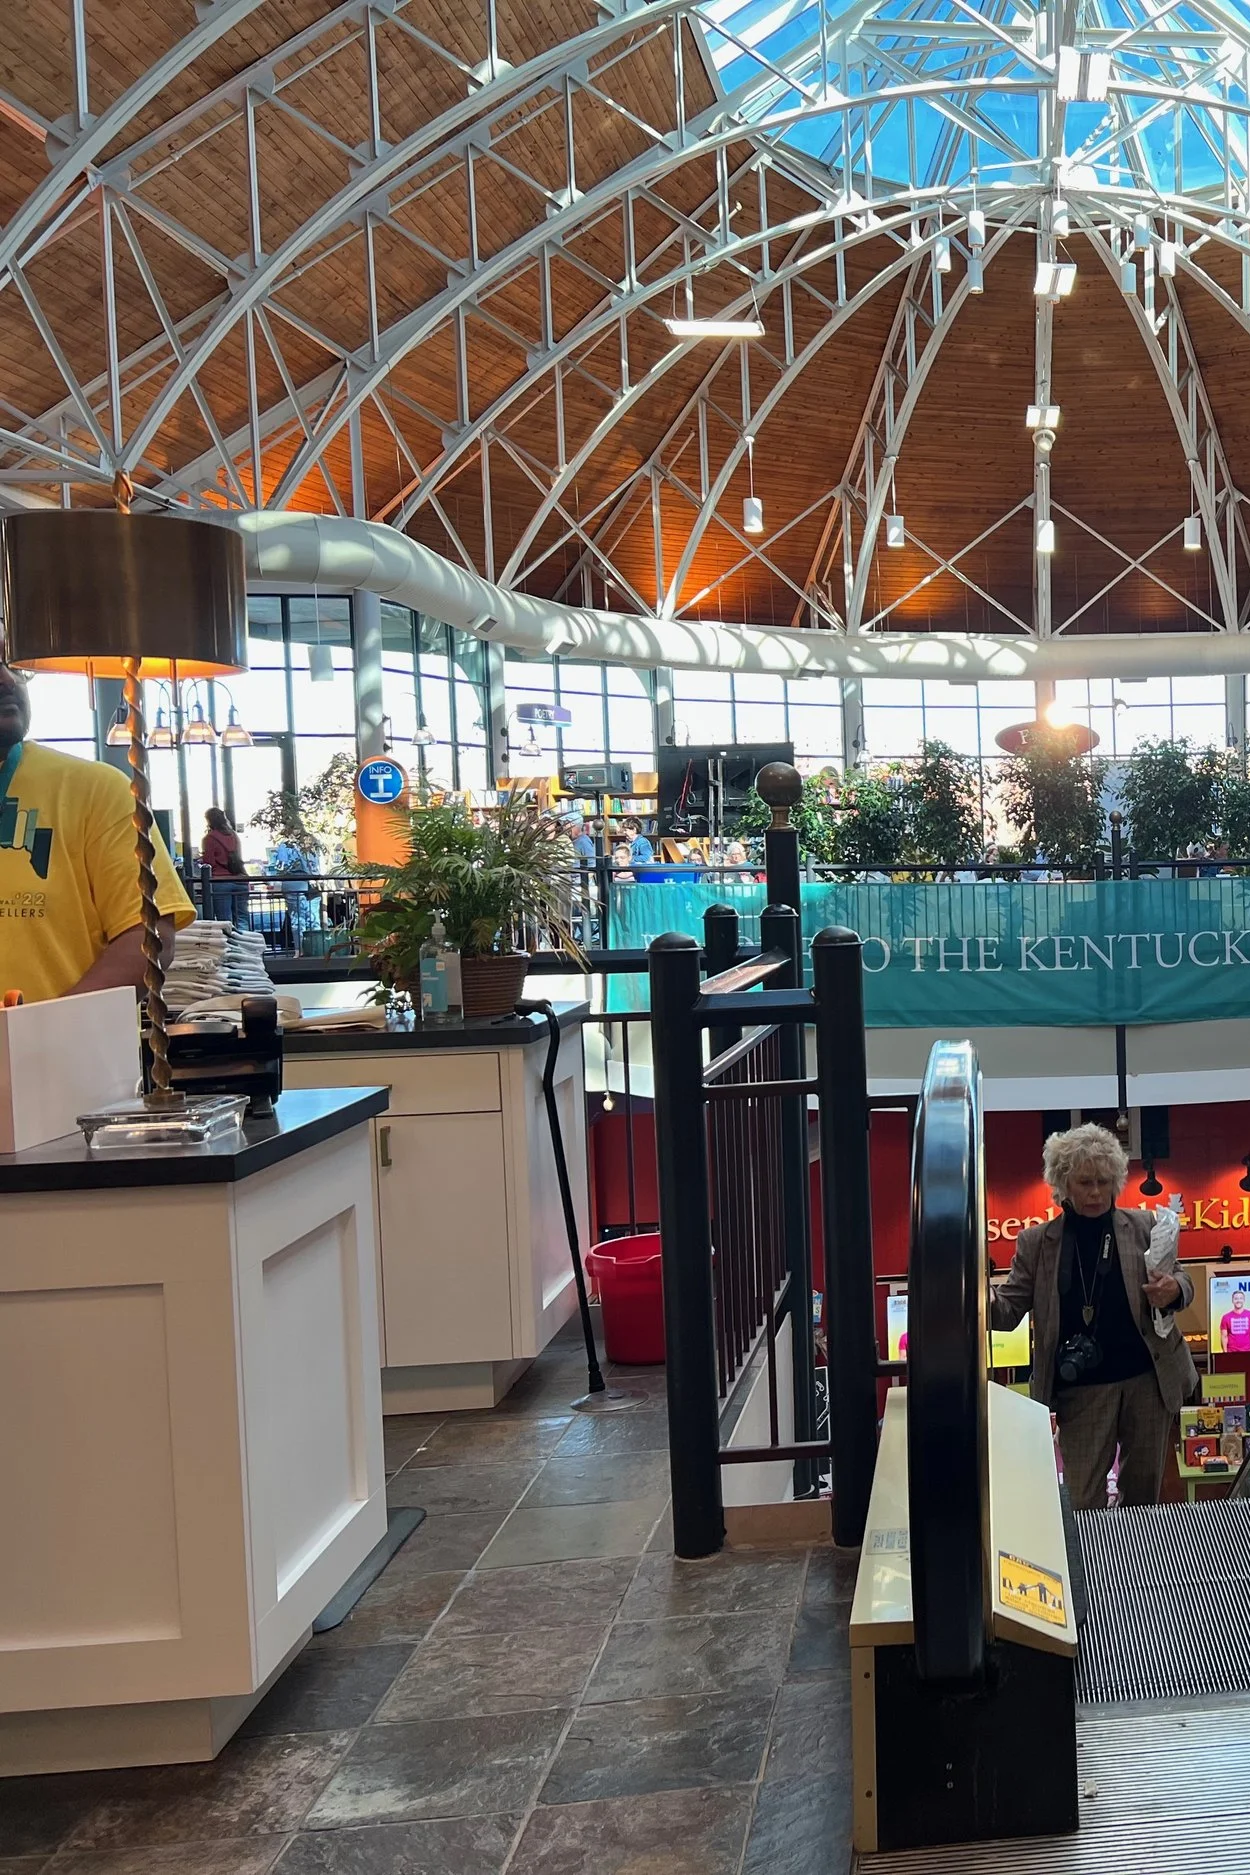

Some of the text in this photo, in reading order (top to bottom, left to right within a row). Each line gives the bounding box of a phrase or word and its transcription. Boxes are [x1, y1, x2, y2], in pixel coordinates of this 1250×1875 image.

[534, 707, 555, 720] POETRY
[368, 765, 392, 775] INFO
[906, 936, 1003, 974] THE
